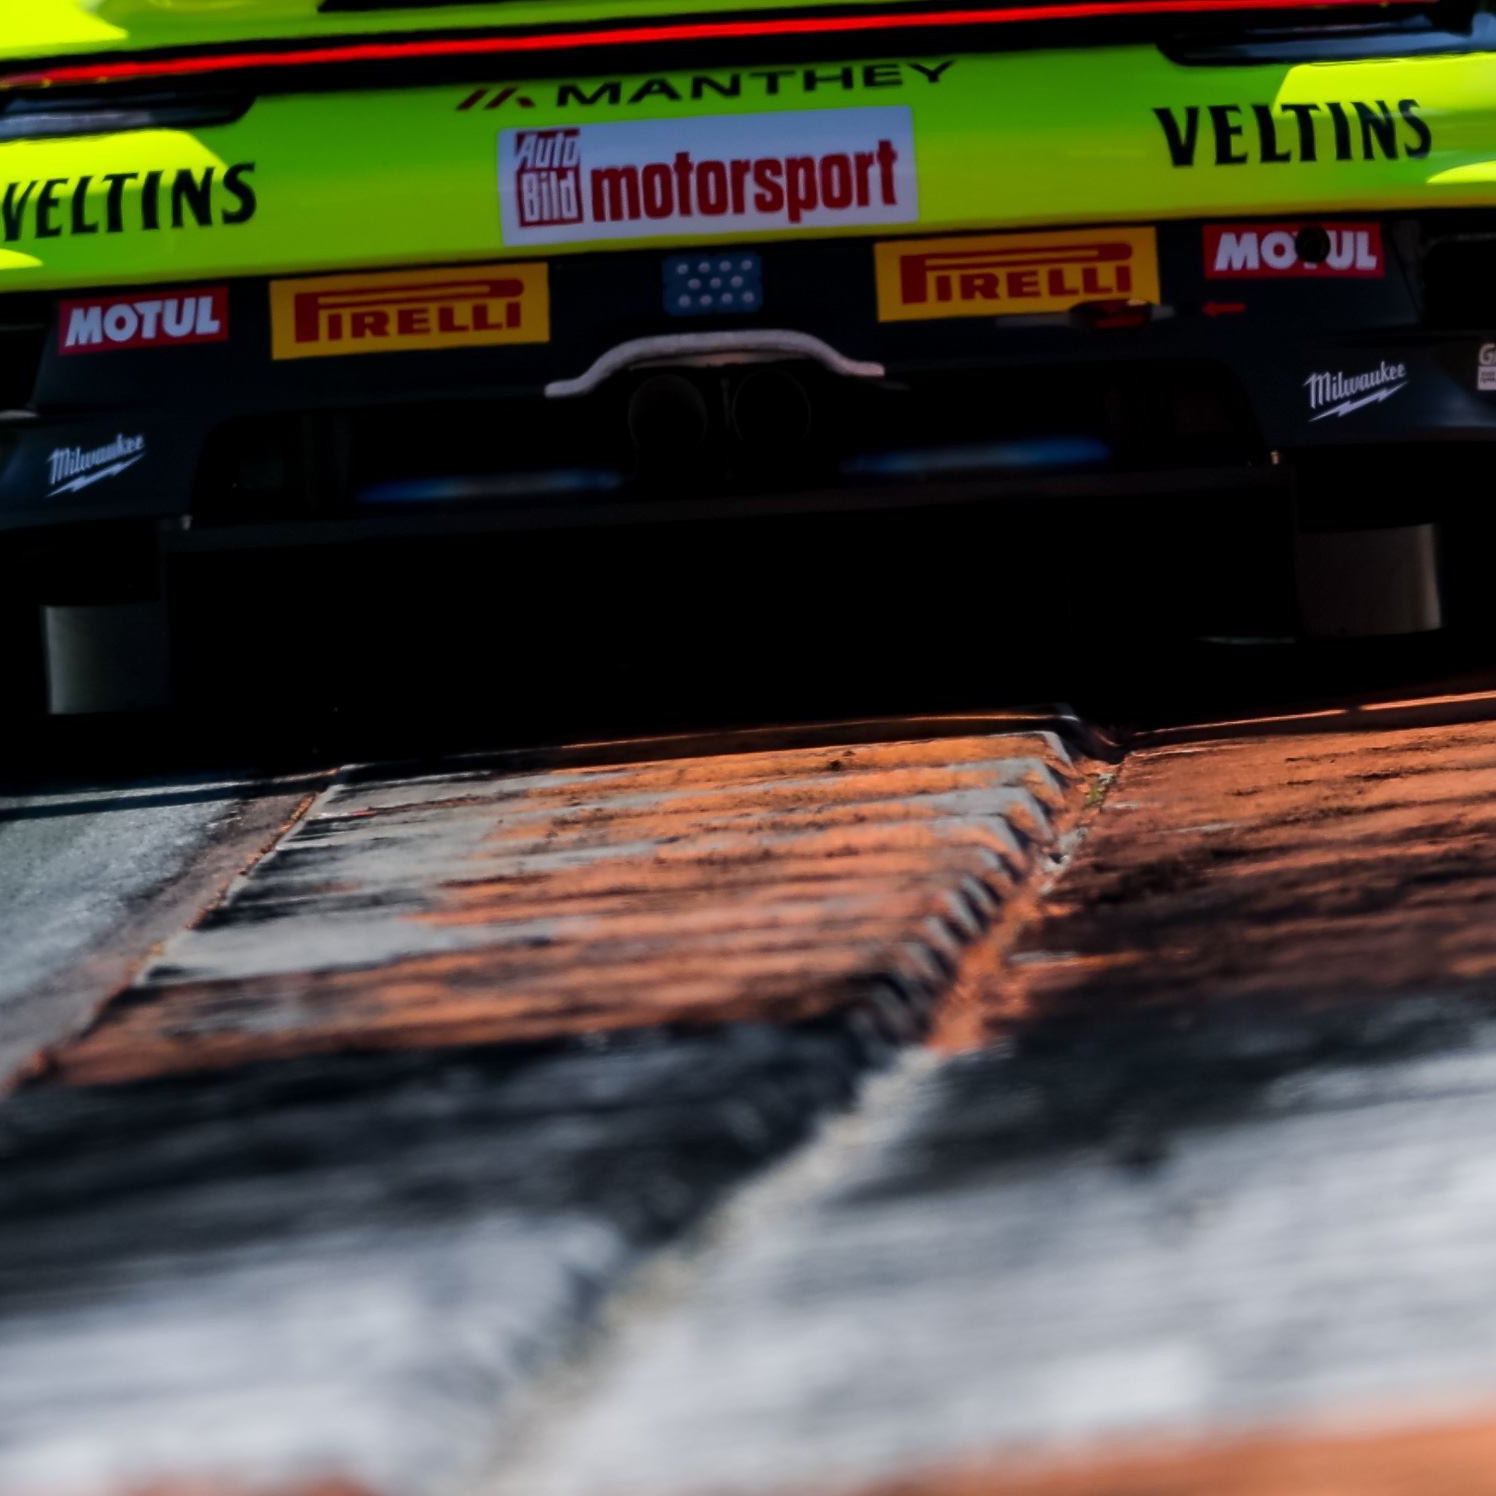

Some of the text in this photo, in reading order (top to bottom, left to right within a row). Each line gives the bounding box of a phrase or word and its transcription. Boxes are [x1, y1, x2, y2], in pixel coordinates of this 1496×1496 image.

[554, 60, 956, 108] MANTHEY
[514, 128, 582, 169] Auto
[1153, 99, 1433, 167] VELTINS
[3, 162, 257, 242] VELTINS
[519, 172, 580, 224] Bild
[590, 140, 899, 224] motorsport
[900, 242, 1134, 304] PIRELLI
[1214, 230, 1378, 272] MOUL
[64, 296, 222, 348] MOTUL
[293, 277, 524, 344] PIRELLI
[1304, 360, 1407, 410] Milwaukee
[47, 434, 146, 484] Milwaukee
